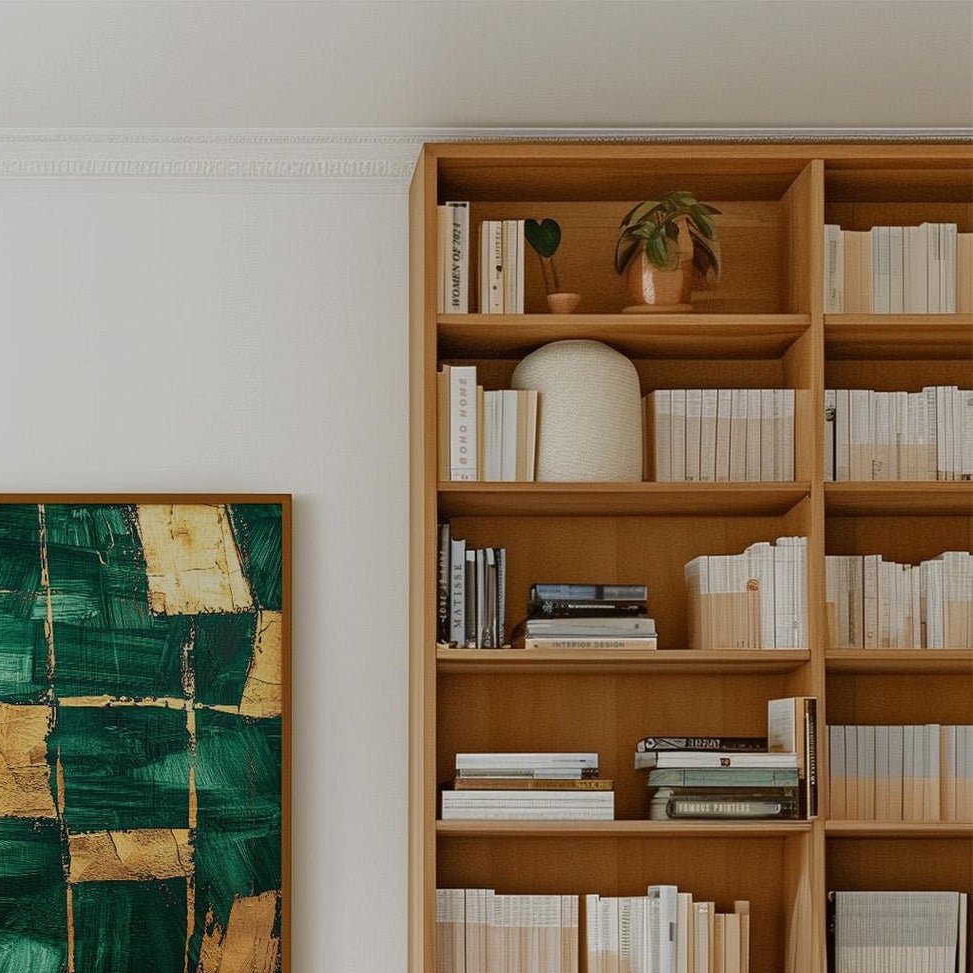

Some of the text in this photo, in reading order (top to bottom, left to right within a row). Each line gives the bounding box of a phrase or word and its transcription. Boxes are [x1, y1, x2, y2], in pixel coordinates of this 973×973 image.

[451, 247, 461, 262] OF
[451, 264, 461, 307] WOMEN
[459, 378, 468, 418] HOME
[459, 425, 468, 465] BOHO
[453, 563, 462, 628] MATISSE
[678, 803, 710, 812] FAMOUS
